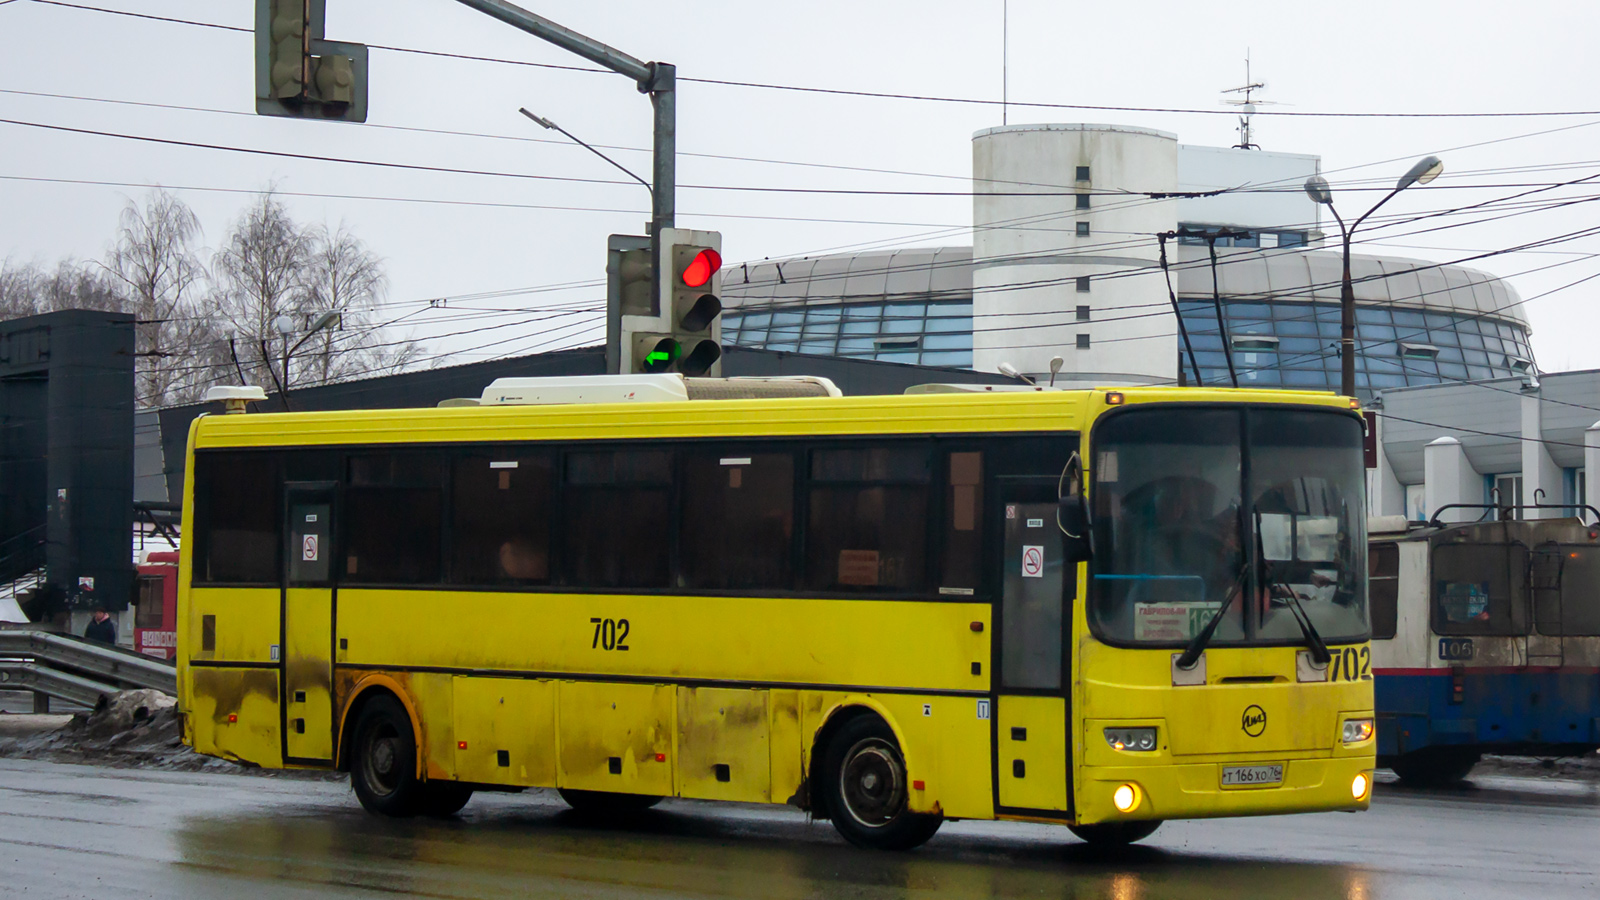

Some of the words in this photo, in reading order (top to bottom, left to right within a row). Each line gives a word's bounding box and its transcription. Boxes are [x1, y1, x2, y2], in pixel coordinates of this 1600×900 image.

[590, 617, 629, 651] 702
[1327, 646, 1372, 682] 702
[1227, 772, 1233, 782] Т
[1235, 769, 1253, 782] 166
[1255, 771, 1267, 780] ХО
[1269, 767, 1279, 777] 76
